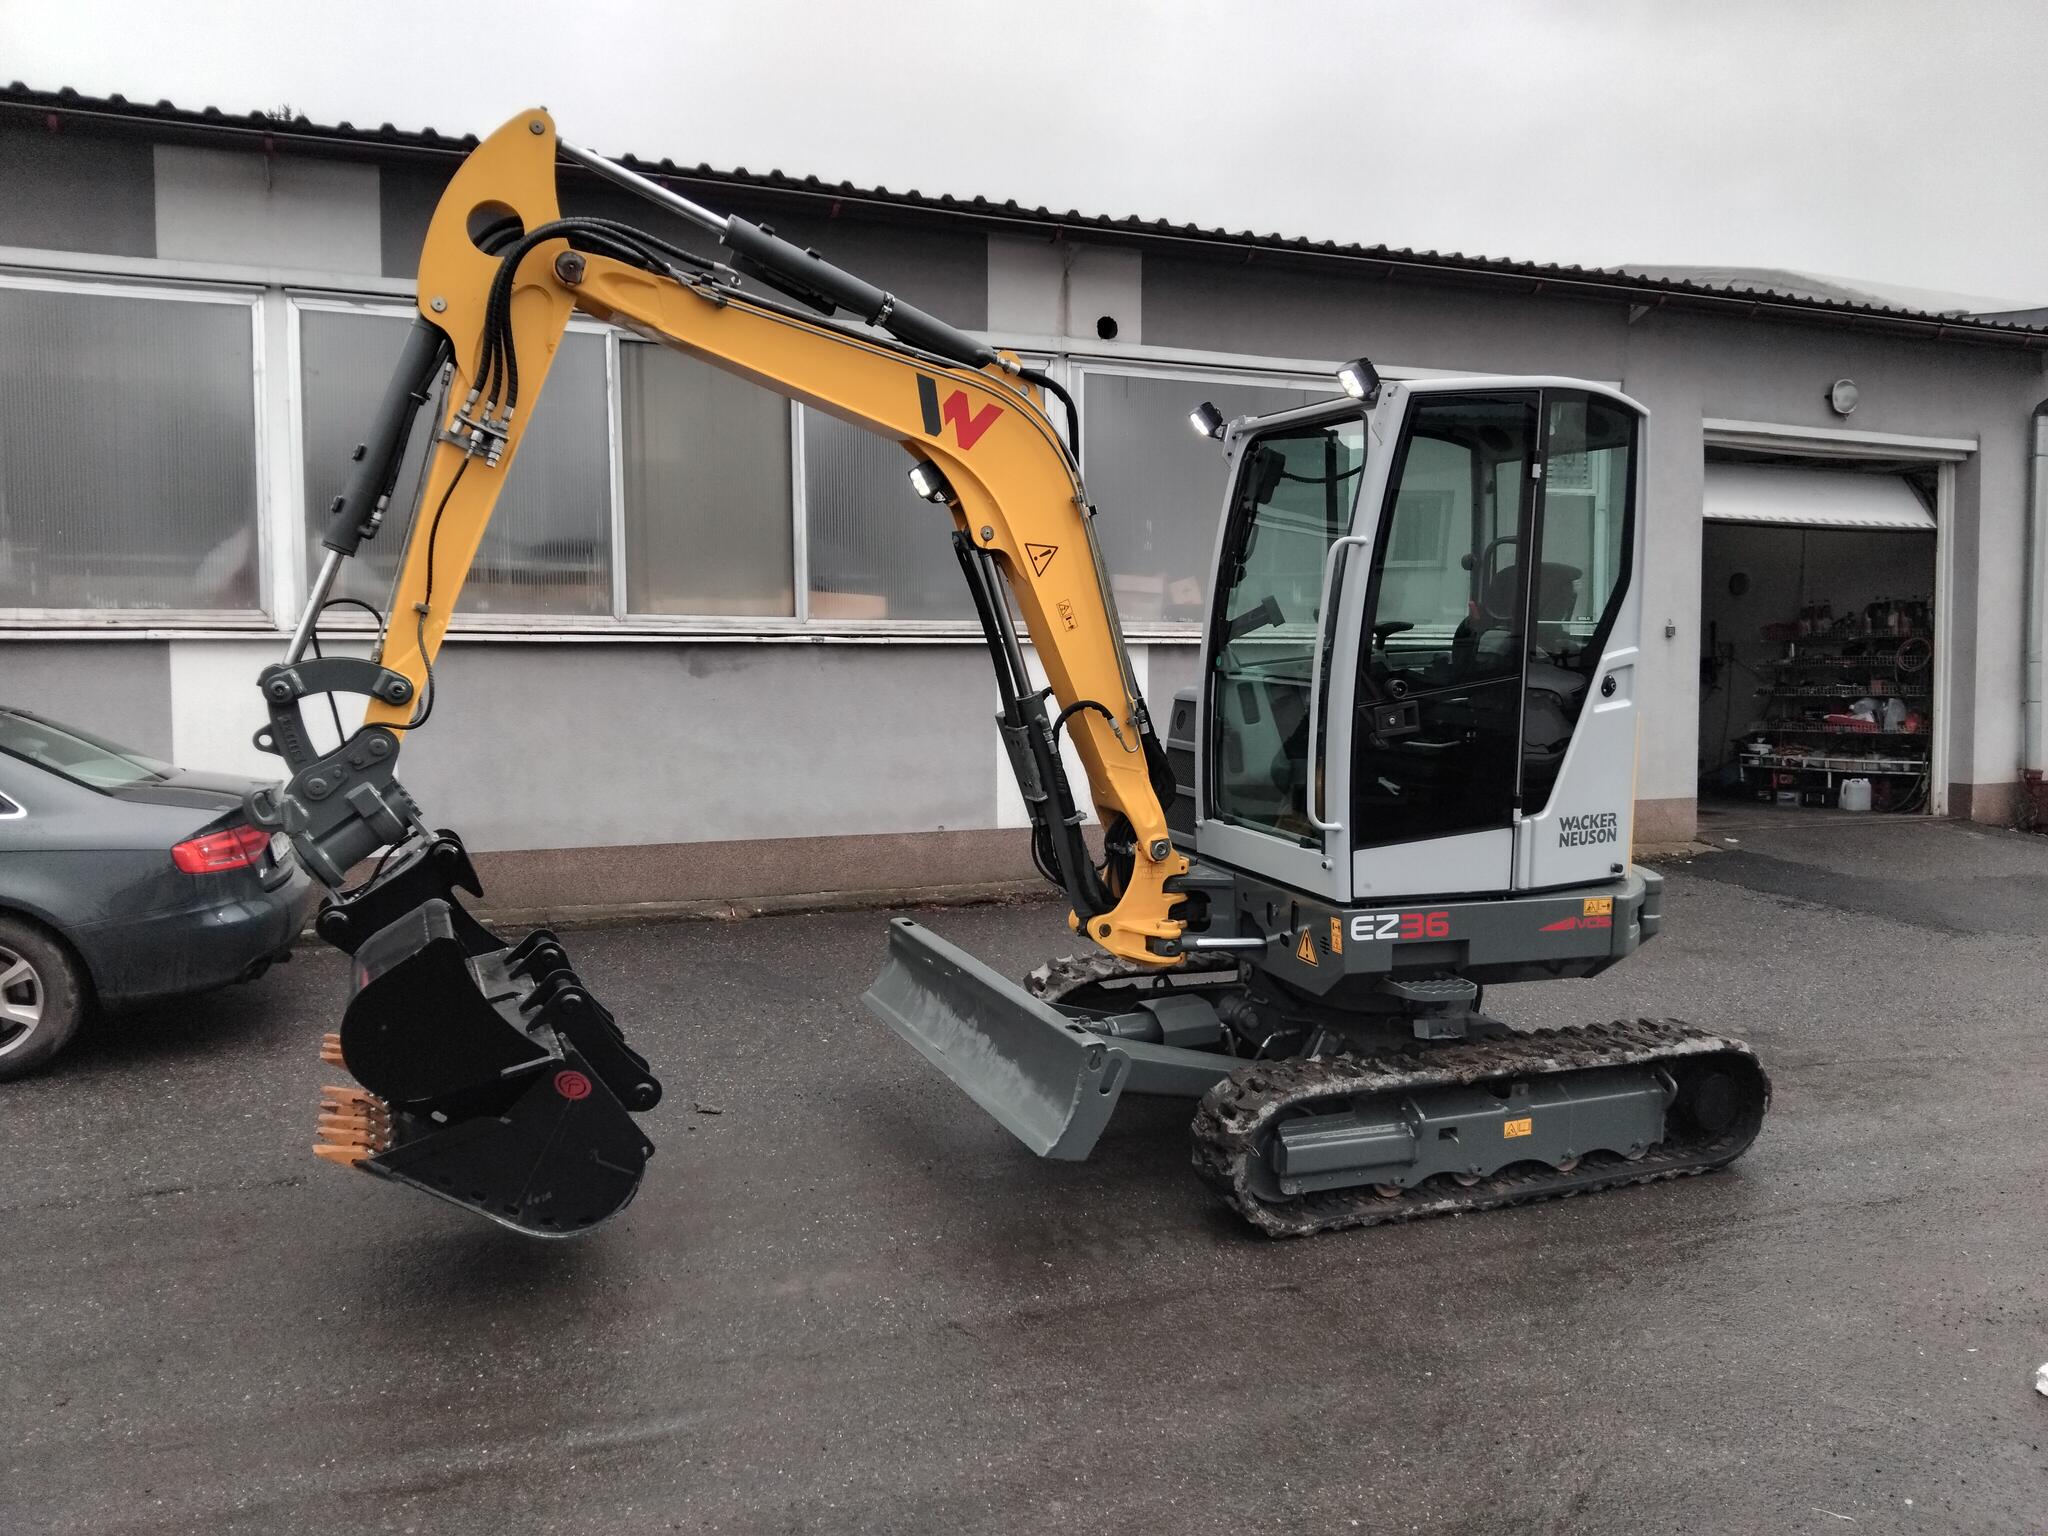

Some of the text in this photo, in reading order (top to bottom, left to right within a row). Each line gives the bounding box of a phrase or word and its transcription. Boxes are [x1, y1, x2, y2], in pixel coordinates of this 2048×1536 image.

[1559, 813, 1617, 831] WACKER
[1559, 828, 1617, 848] NEUSON
[1350, 911, 1449, 941] EZ36
